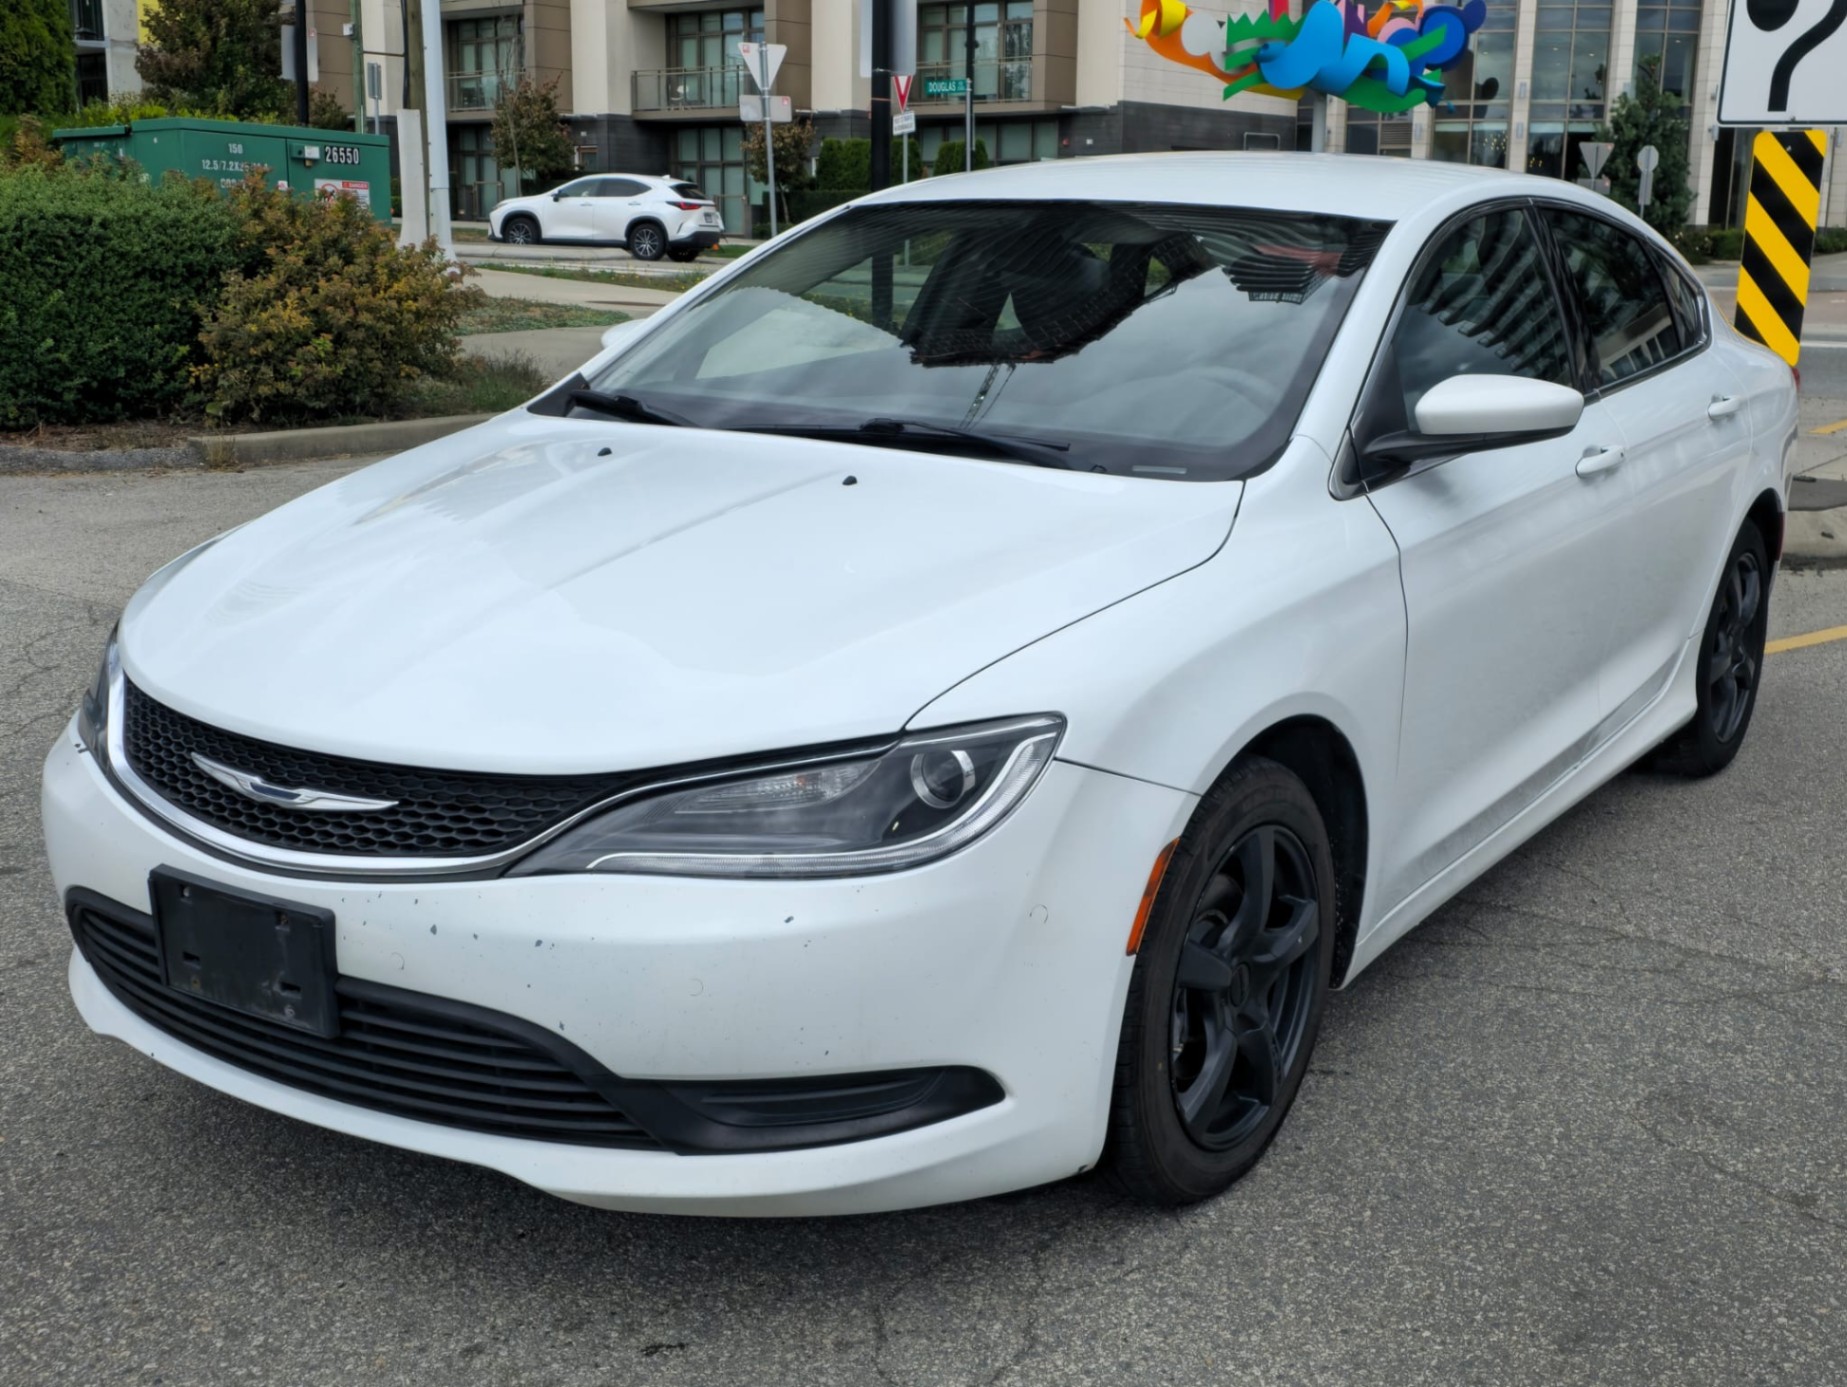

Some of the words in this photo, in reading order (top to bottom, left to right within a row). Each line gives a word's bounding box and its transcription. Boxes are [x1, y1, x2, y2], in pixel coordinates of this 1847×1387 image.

[928, 81, 957, 92] DOUGLAS
[228, 143, 244, 154] 150
[325, 146, 360, 164] 26550
